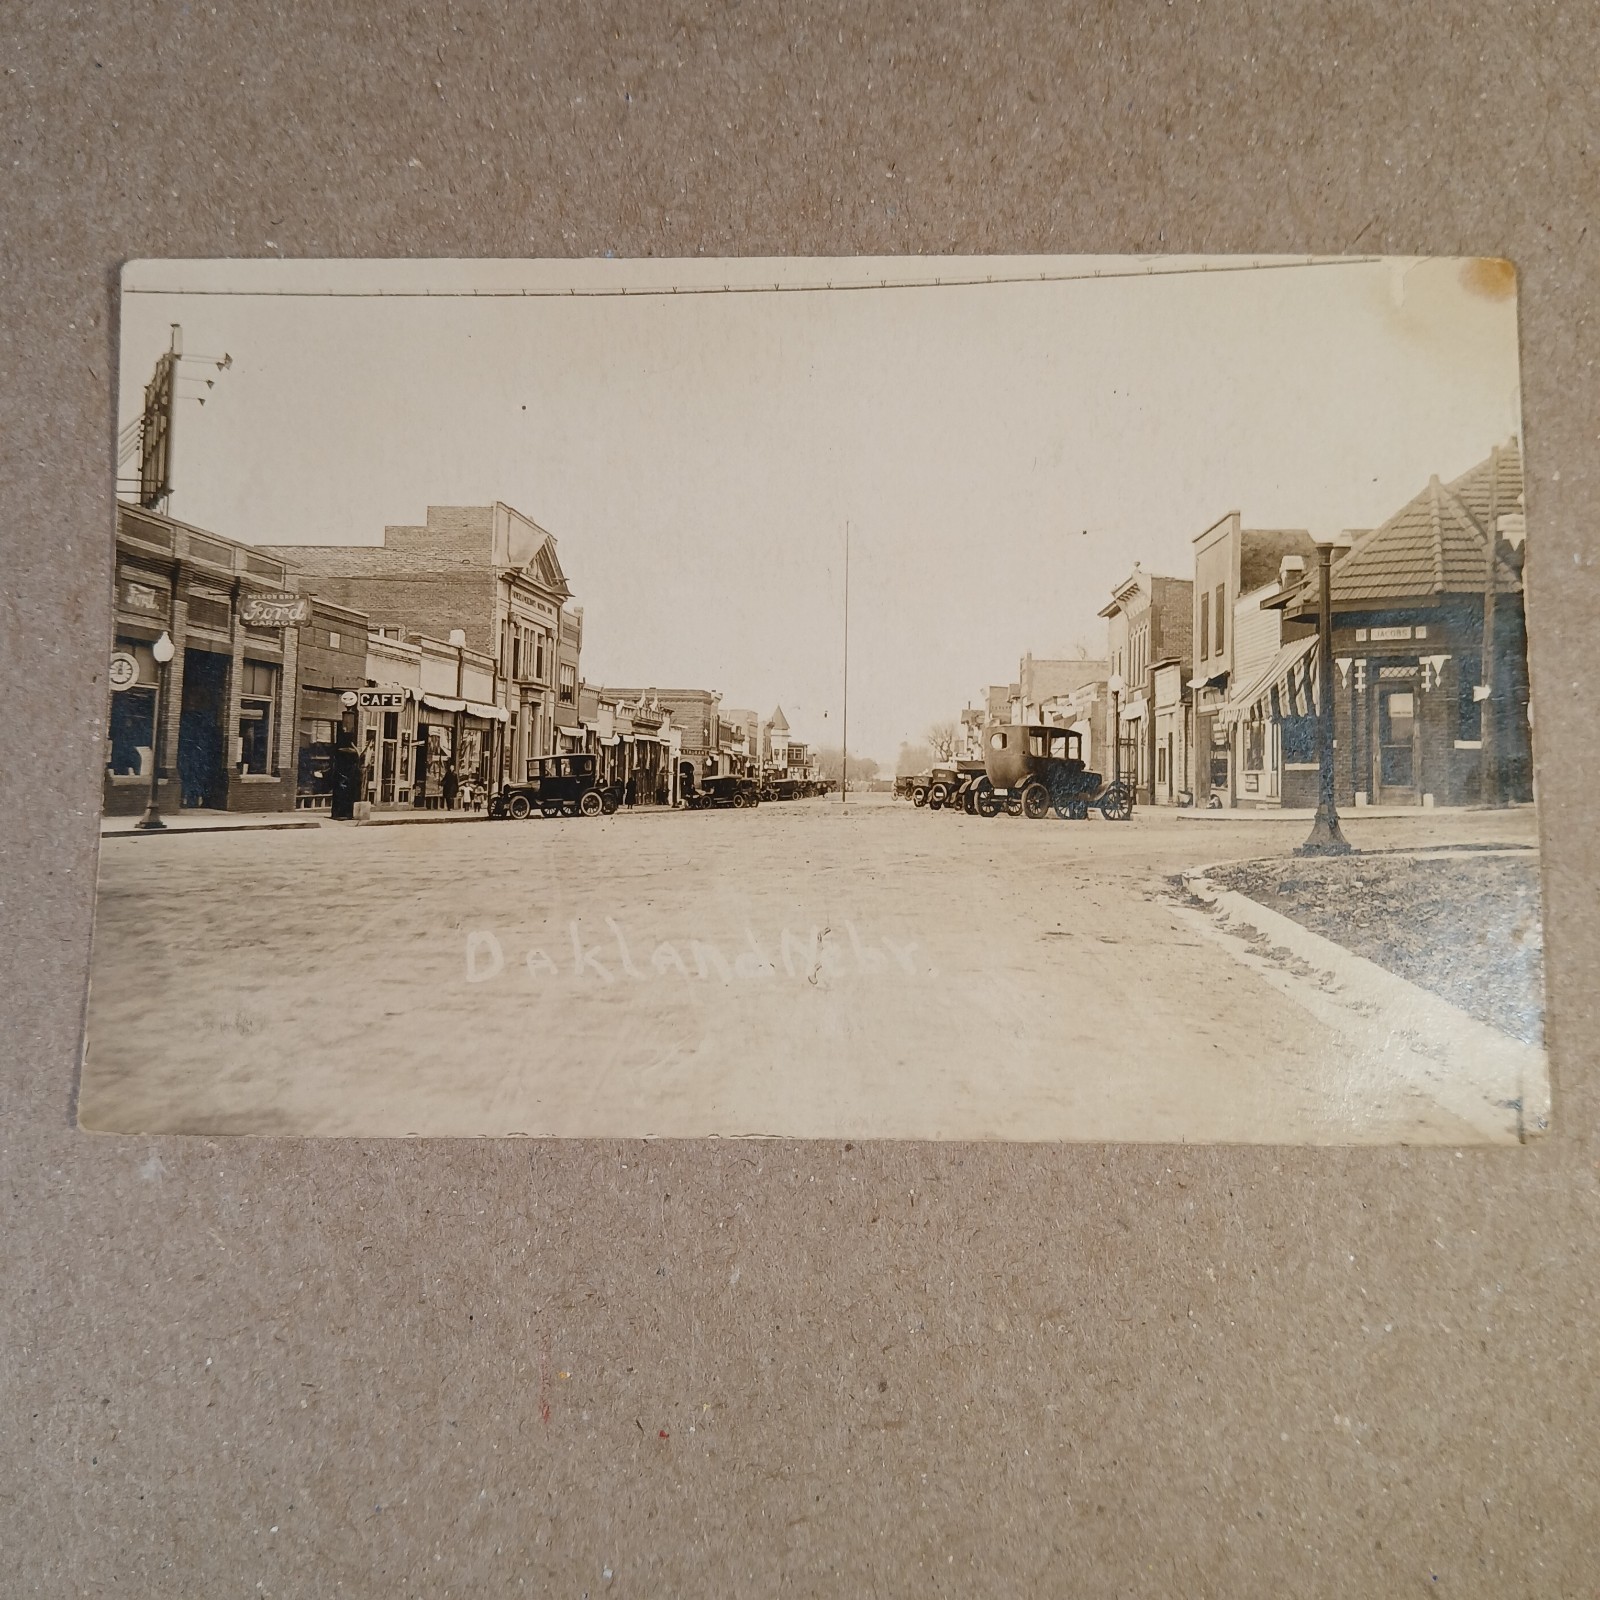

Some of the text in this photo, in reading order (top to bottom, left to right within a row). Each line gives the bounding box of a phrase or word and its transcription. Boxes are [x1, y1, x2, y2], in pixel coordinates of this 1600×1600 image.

[243, 599, 307, 620] Ford
[1377, 628, 1408, 639] JACOBS
[360, 693, 402, 706] CAFE
